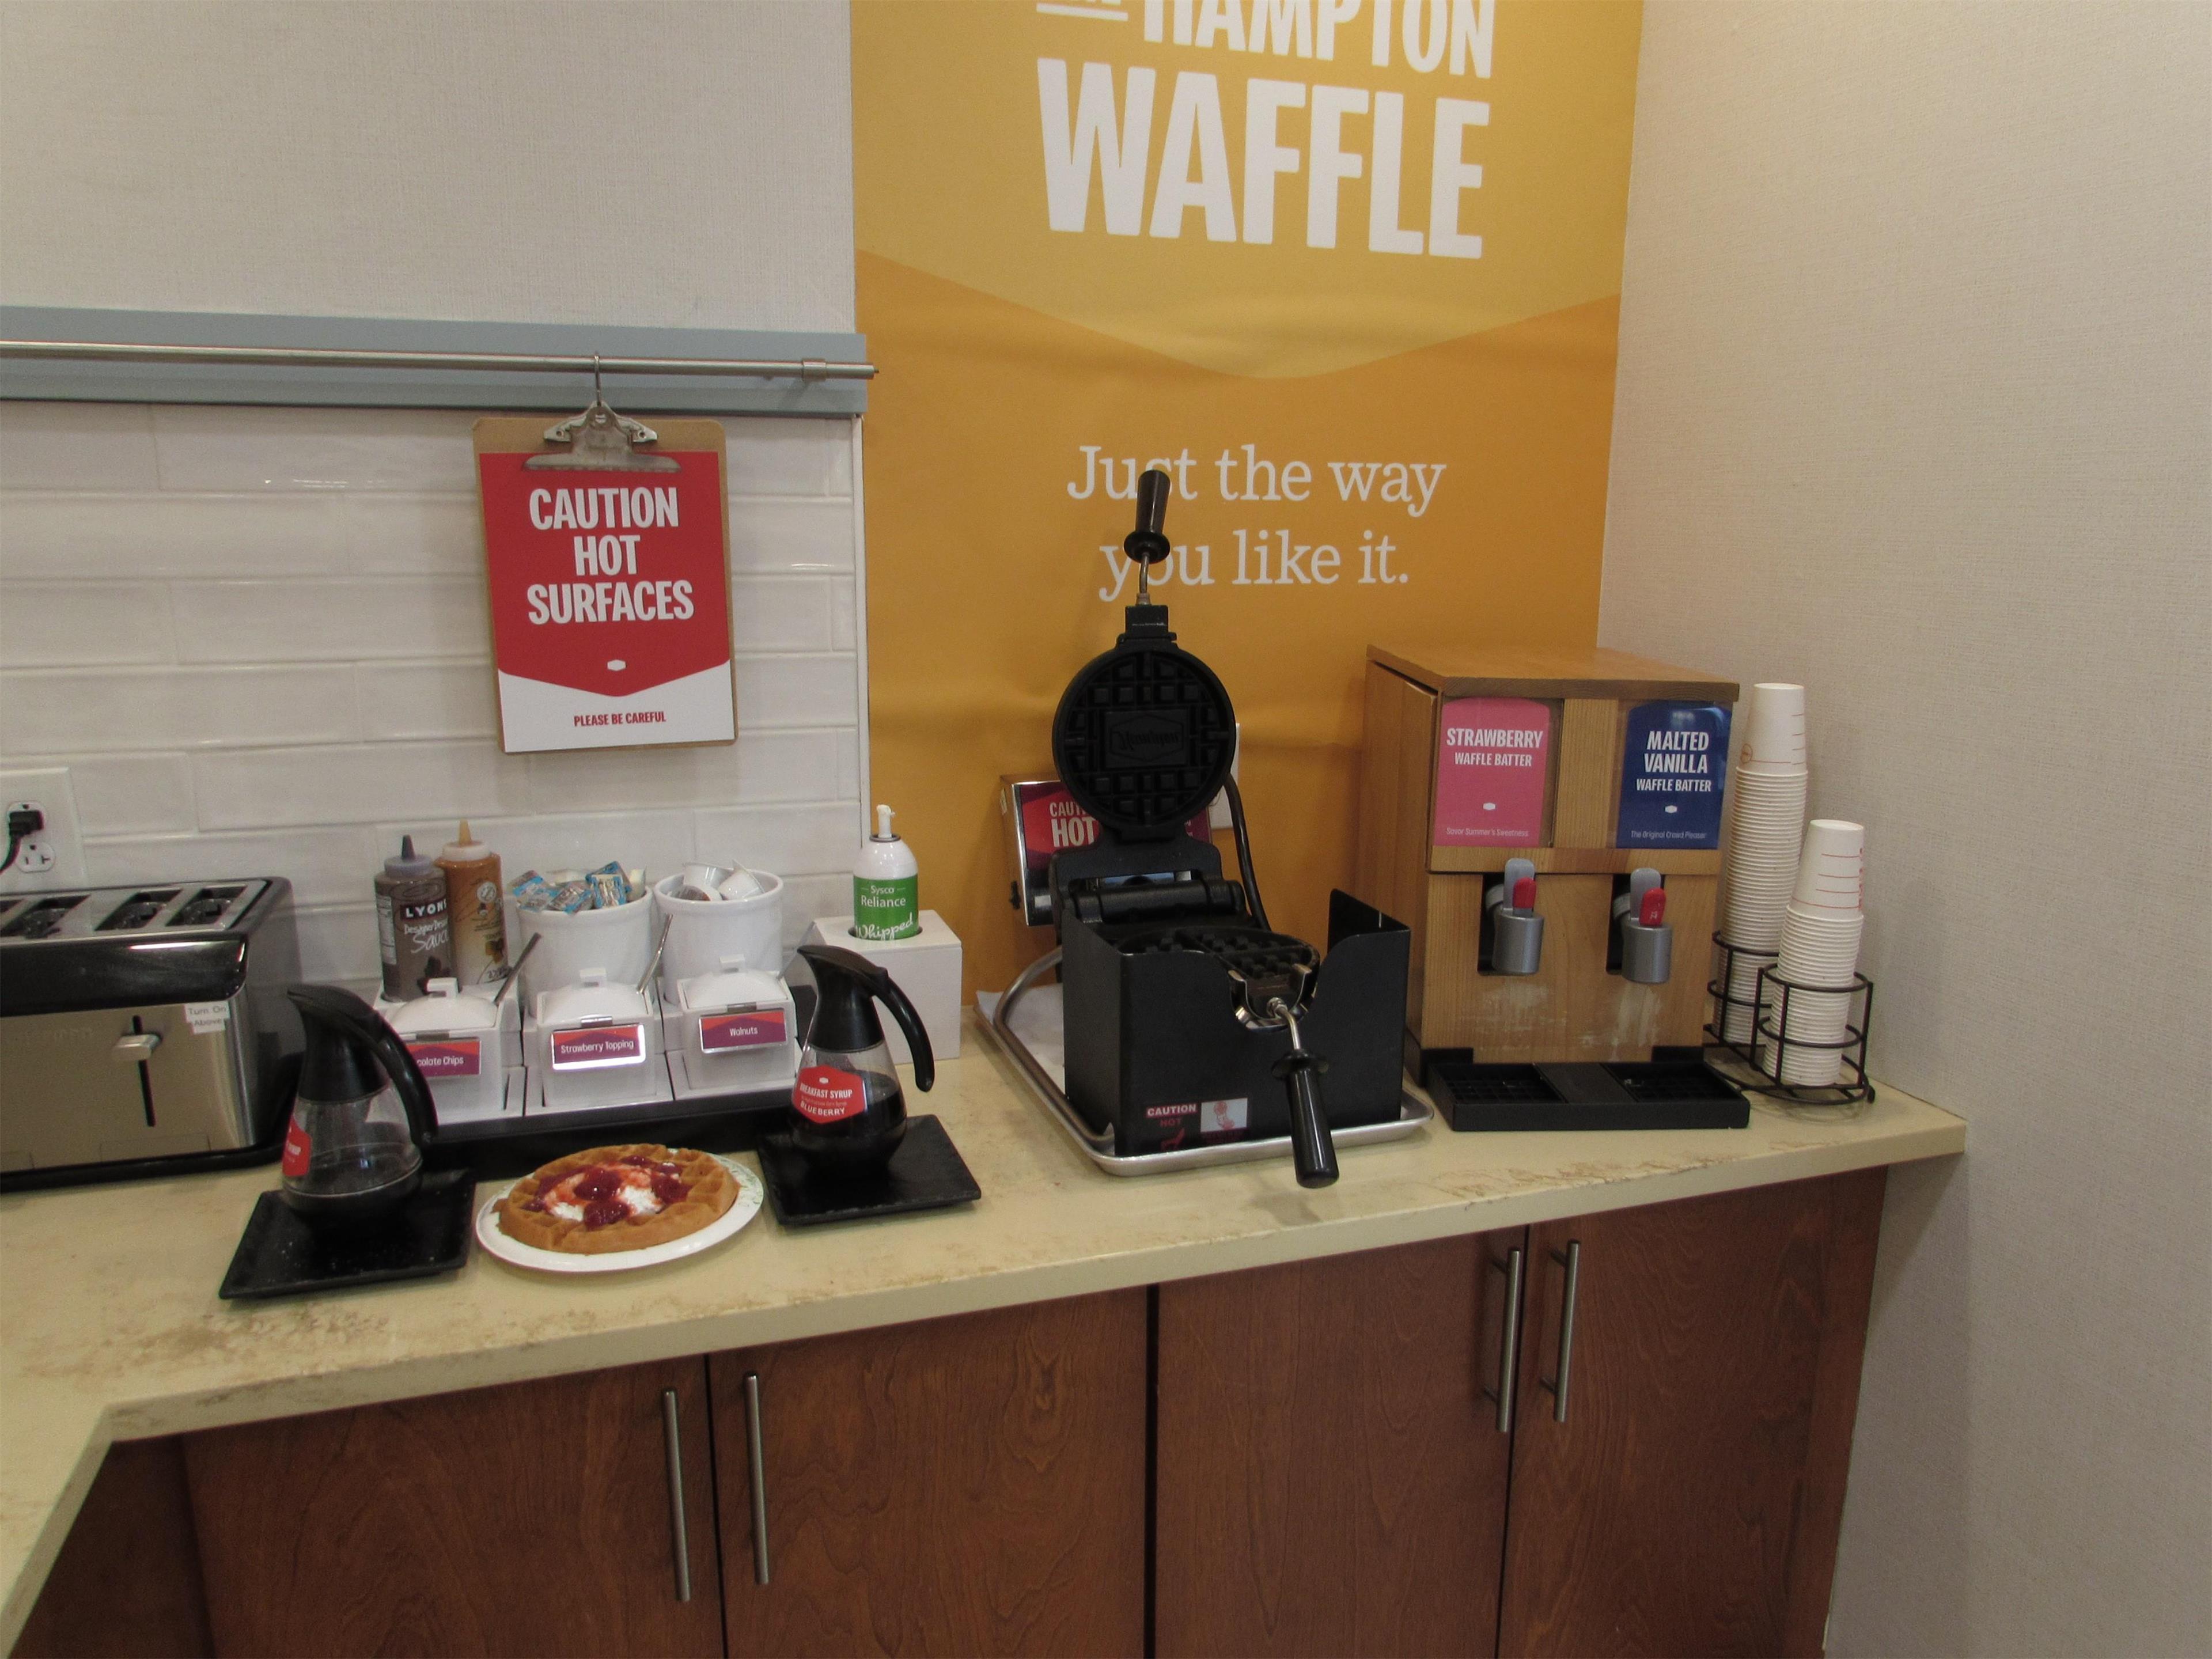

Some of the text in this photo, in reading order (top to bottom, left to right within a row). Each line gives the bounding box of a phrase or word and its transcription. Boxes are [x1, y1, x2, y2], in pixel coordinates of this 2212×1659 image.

[1037, 58, 1490, 259] WAFFLE
[1215, 444, 1312, 501] the
[1327, 461, 1446, 517] way
[529, 487, 679, 530] CAUTION
[574, 535, 640, 575] HOT
[1232, 529, 1340, 585] like
[1358, 529, 1409, 585] it.
[527, 580, 694, 625] SURFACES
[574, 711, 666, 726] PLEASE BE CAREFUL
[1446, 728, 1544, 748] STRAWBERRY
[1646, 730, 1709, 751] MALTED
[1455, 752, 1532, 767] WAFFLE BATTER
[1644, 753, 1708, 774] VANILLA
[1637, 779, 1711, 792] WAFFLE BATTER
[1050, 801, 1086, 817] CAUT
[1051, 817, 1096, 847] HOT
[1465, 828, 1495, 836] Summer's
[870, 885, 894, 895] Sysco
[861, 895, 906, 907] Reliance
[855, 912, 913, 940] Whipped
[729, 1027, 758, 1036] Walnuts
[561, 1040, 634, 1054] Strawberry Topping
[416, 1055, 464, 1067] colate Chips
[830, 1089, 853, 1099] SYRUP
[1147, 1104, 1196, 1116] CAUTION
